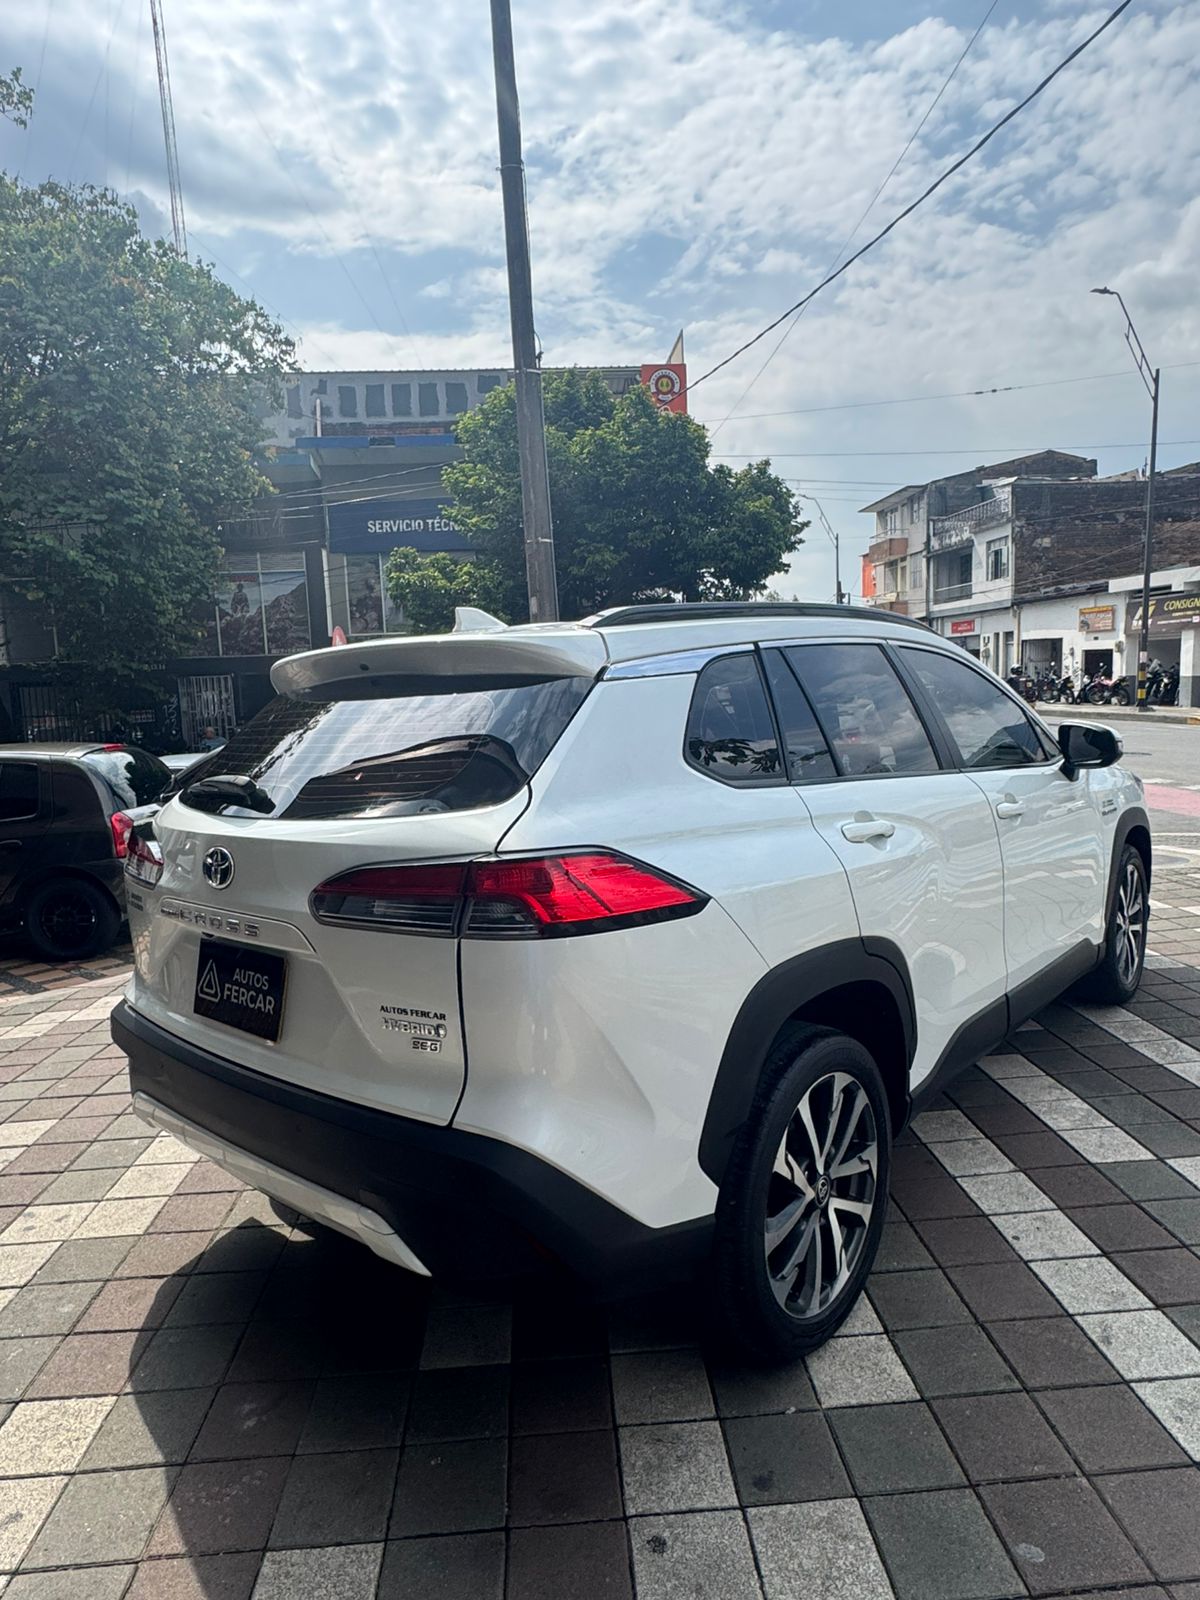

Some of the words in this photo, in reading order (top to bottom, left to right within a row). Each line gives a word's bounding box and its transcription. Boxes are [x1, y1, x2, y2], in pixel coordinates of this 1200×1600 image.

[367, 519, 424, 533] SERVICIO
[232, 967, 269, 990] AUTOS
[223, 983, 275, 1015] FERCAR
[380, 1005, 409, 1016] AUTOS
[409, 1009, 447, 1021] FERCAR
[382, 1016, 436, 1037] HYBRID
